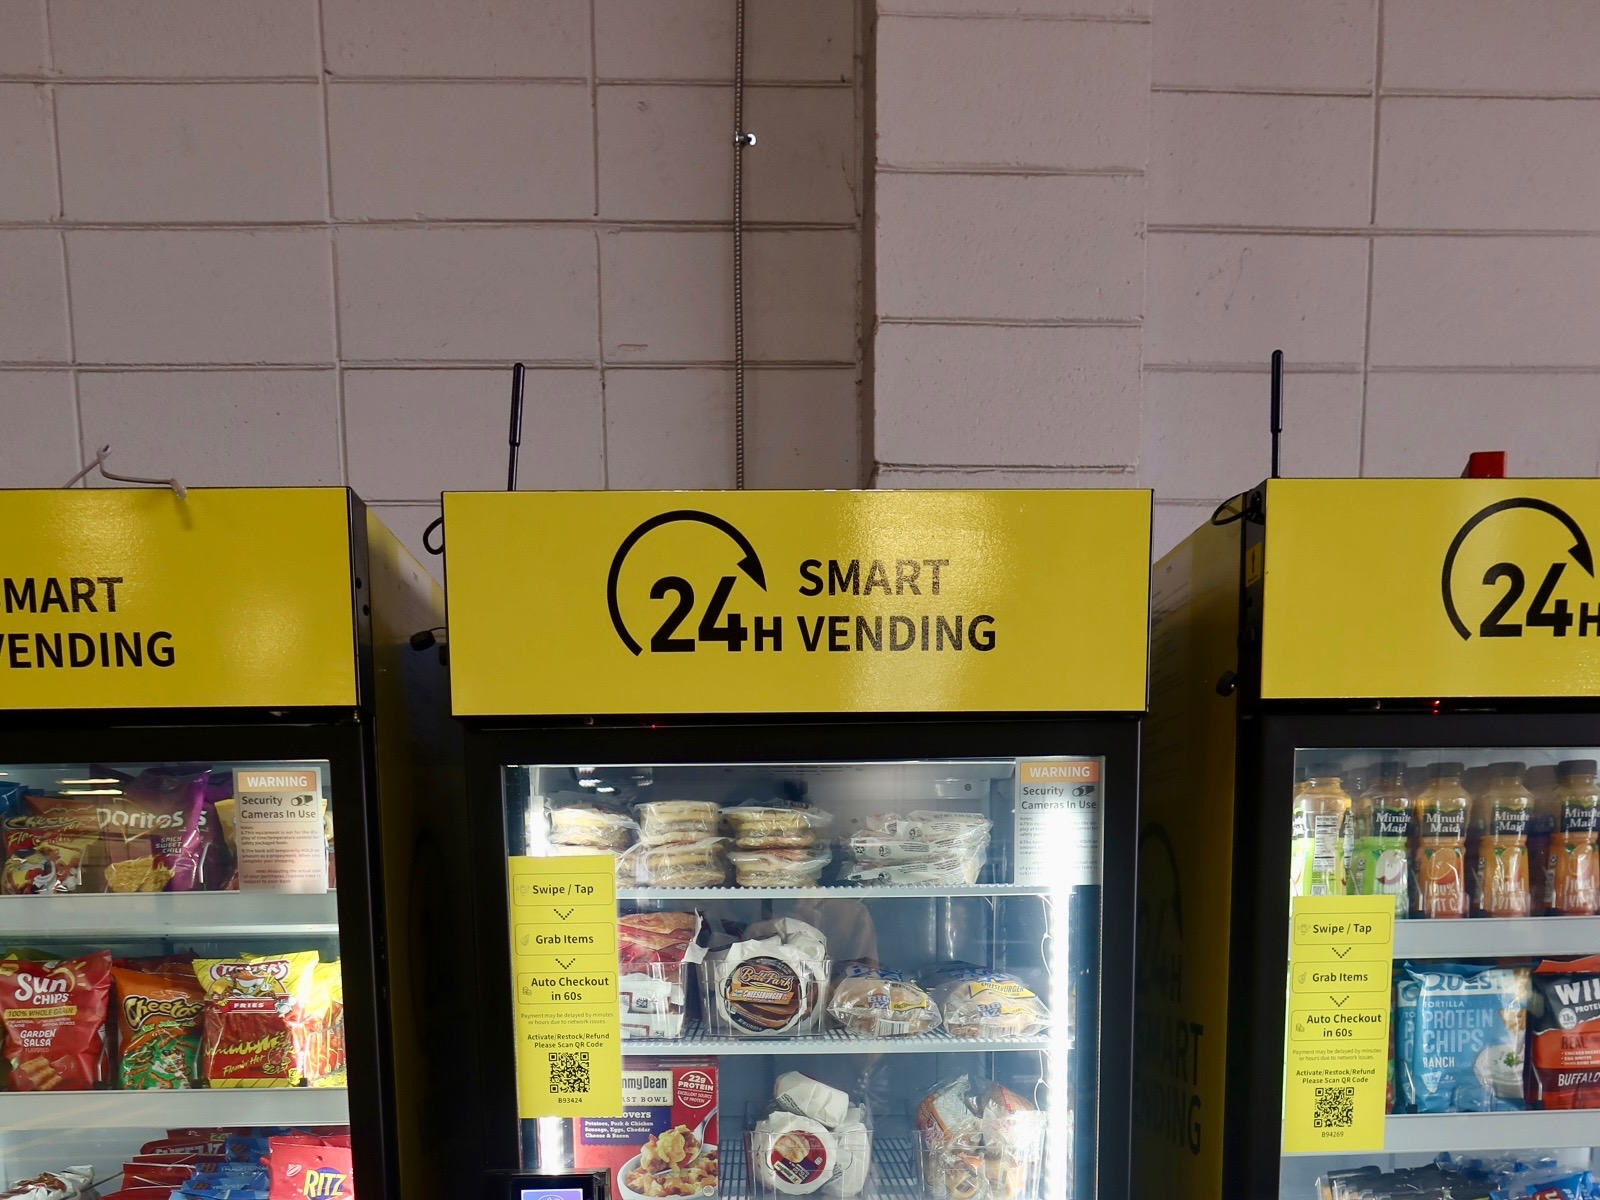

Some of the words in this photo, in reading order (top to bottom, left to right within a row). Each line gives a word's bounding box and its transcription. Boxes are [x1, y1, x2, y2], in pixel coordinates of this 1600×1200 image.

[798, 559, 950, 597] SMART
[0, 577, 123, 613] MART
[649, 576, 782, 653] 24H
[797, 614, 997, 653] VENDING
[0, 631, 175, 667] ENDING
[1030, 766, 1090, 778] WARNING
[247, 776, 308, 787] WARNING
[1022, 786, 1064, 796] Security
[242, 796, 282, 806] Security
[1021, 801, 1064, 810] Cameras
[97, 808, 184, 830] Doritos
[241, 810, 284, 819] Cameras
[286, 810, 296, 818] In
[298, 810, 316, 818] Use
[1376, 812, 1411, 823] Minute
[1426, 812, 1465, 824] Minute
[1495, 811, 1530, 822] Minute
[1380, 822, 1407, 833] Maid
[1430, 822, 1460, 833] Maid
[1498, 820, 1526, 832] Maid
[1569, 818, 1597, 828] Maid
[532, 884, 565, 896] Swipe
[574, 884, 594, 896] Tap
[1312, 924, 1344, 934] Swipe
[1354, 924, 1372, 934] Tap
[536, 934, 561, 945] Grab
[564, 934, 594, 944] Items
[530, 977, 557, 988] Auto
[558, 976, 609, 987] Checkout
[1312, 972, 1337, 982] Grab
[1339, 972, 1368, 982] Items
[14, 973, 67, 1002] Sun
[32, 993, 70, 1005] CHIPS
[551, 991, 561, 1001] in
[564, 991, 582, 1000] 60s
[742, 990, 783, 1000] CHEESEBURGER
[53, 1007, 74, 1016] GRAIN
[123, 994, 204, 1031] Cheetos
[1306, 1014, 1331, 1024] Auto
[1333, 1014, 1382, 1023] Checkout
[1422, 1008, 1494, 1030] PROTEIN
[20, 1028, 57, 1038] GARDEN
[1323, 1028, 1333, 1037] in
[1336, 1028, 1353, 1037] 60s
[23, 1038, 52, 1047] SALSA
[1422, 1029, 1484, 1054] CHIPS
[1422, 1056, 1455, 1069] RANCH
[1296, 1068, 1376, 1076] Activate/Restock/Refund
[688, 1074, 706, 1084] 22g
[678, 1081, 714, 1092] PROTEIN
[304, 1169, 347, 1198] RITZ
